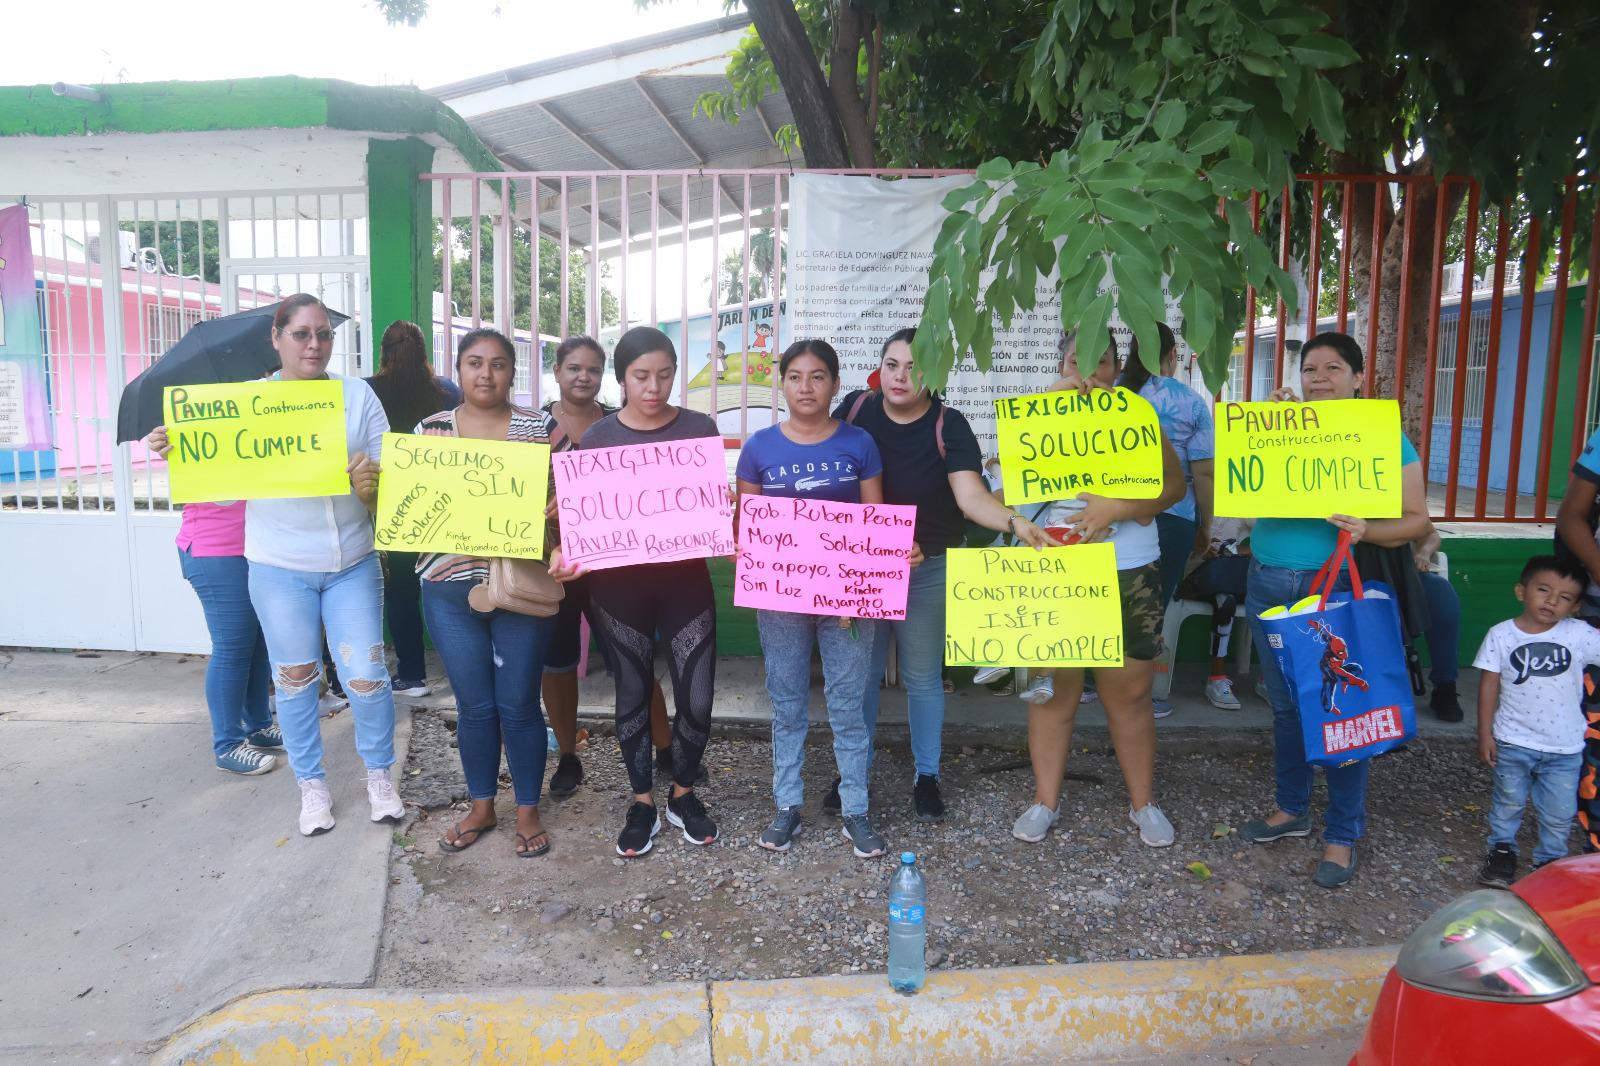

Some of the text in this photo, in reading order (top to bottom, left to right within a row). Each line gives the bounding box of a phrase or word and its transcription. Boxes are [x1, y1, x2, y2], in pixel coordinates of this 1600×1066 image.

[812, 250, 852, 258] GRACIELA
[856, 250, 908, 259] DOMÍNGUEZ
[796, 264, 836, 272] Secretaria
[838, 264, 848, 272] de
[851, 264, 892, 272] Educación
[894, 264, 924, 272] Pública
[795, 283, 808, 291] Los
[810, 284, 838, 292] padres
[840, 284, 849, 292] de
[852, 284, 878, 292] familia
[880, 284, 893, 292] del
[812, 298, 846, 307] empresa
[896, 297, 924, 305] "PAVIR
[762, 306, 773, 319] DE
[794, 310, 856, 318] Infraestructura
[860, 310, 883, 318] Física
[888, 310, 922, 318] Educativ
[1042, 314, 1058, 323] que
[1018, 325, 1030, 334] del
[1033, 326, 1060, 336] progra
[830, 336, 865, 344] DIRECTA
[1004, 340, 1040, 351] registros
[1018, 352, 1029, 360] DE
[990, 364, 1038, 373] ALEJANDRO
[956, 385, 978, 394] sigue
[996, 385, 1033, 394] ENERGÍA
[170, 388, 335, 423] PAVIRA Construcciones
[1226, 402, 1320, 432] PAVIRA
[180, 428, 321, 463] NO CUMPLE
[1020, 424, 1158, 461] SOLUCION
[1248, 432, 1361, 450] Construcciones
[394, 437, 504, 472] SEGUIMOS
[768, 462, 852, 481] LACOSTE
[1228, 454, 1388, 494] NO CUMPLE
[464, 470, 524, 498] SIN
[1022, 468, 1161, 498] PAVIRA Construcciones
[377, 482, 428, 546] Queremos
[793, 499, 853, 524] Ruben
[446, 530, 472, 541] Kinder
[489, 516, 533, 539] LUZ
[455, 542, 538, 555] Alejandro Quijano
[564, 529, 722, 556] PAVIRA RESPONDE
[748, 528, 912, 560] Moya. Solicitamos
[979, 550, 1066, 574] PAVIRA
[740, 574, 768, 592] Sin
[838, 564, 903, 586] Seguimos
[953, 581, 1112, 601] CONSTRUCCIONE
[857, 606, 904, 619] Quijano
[978, 610, 1059, 629] ISIFE
[1017, 604, 1027, 616] e
[946, 634, 1004, 662] ¡NO
[1515, 648, 1567, 678] Yes!!
[1324, 708, 1402, 753] MARVEL
